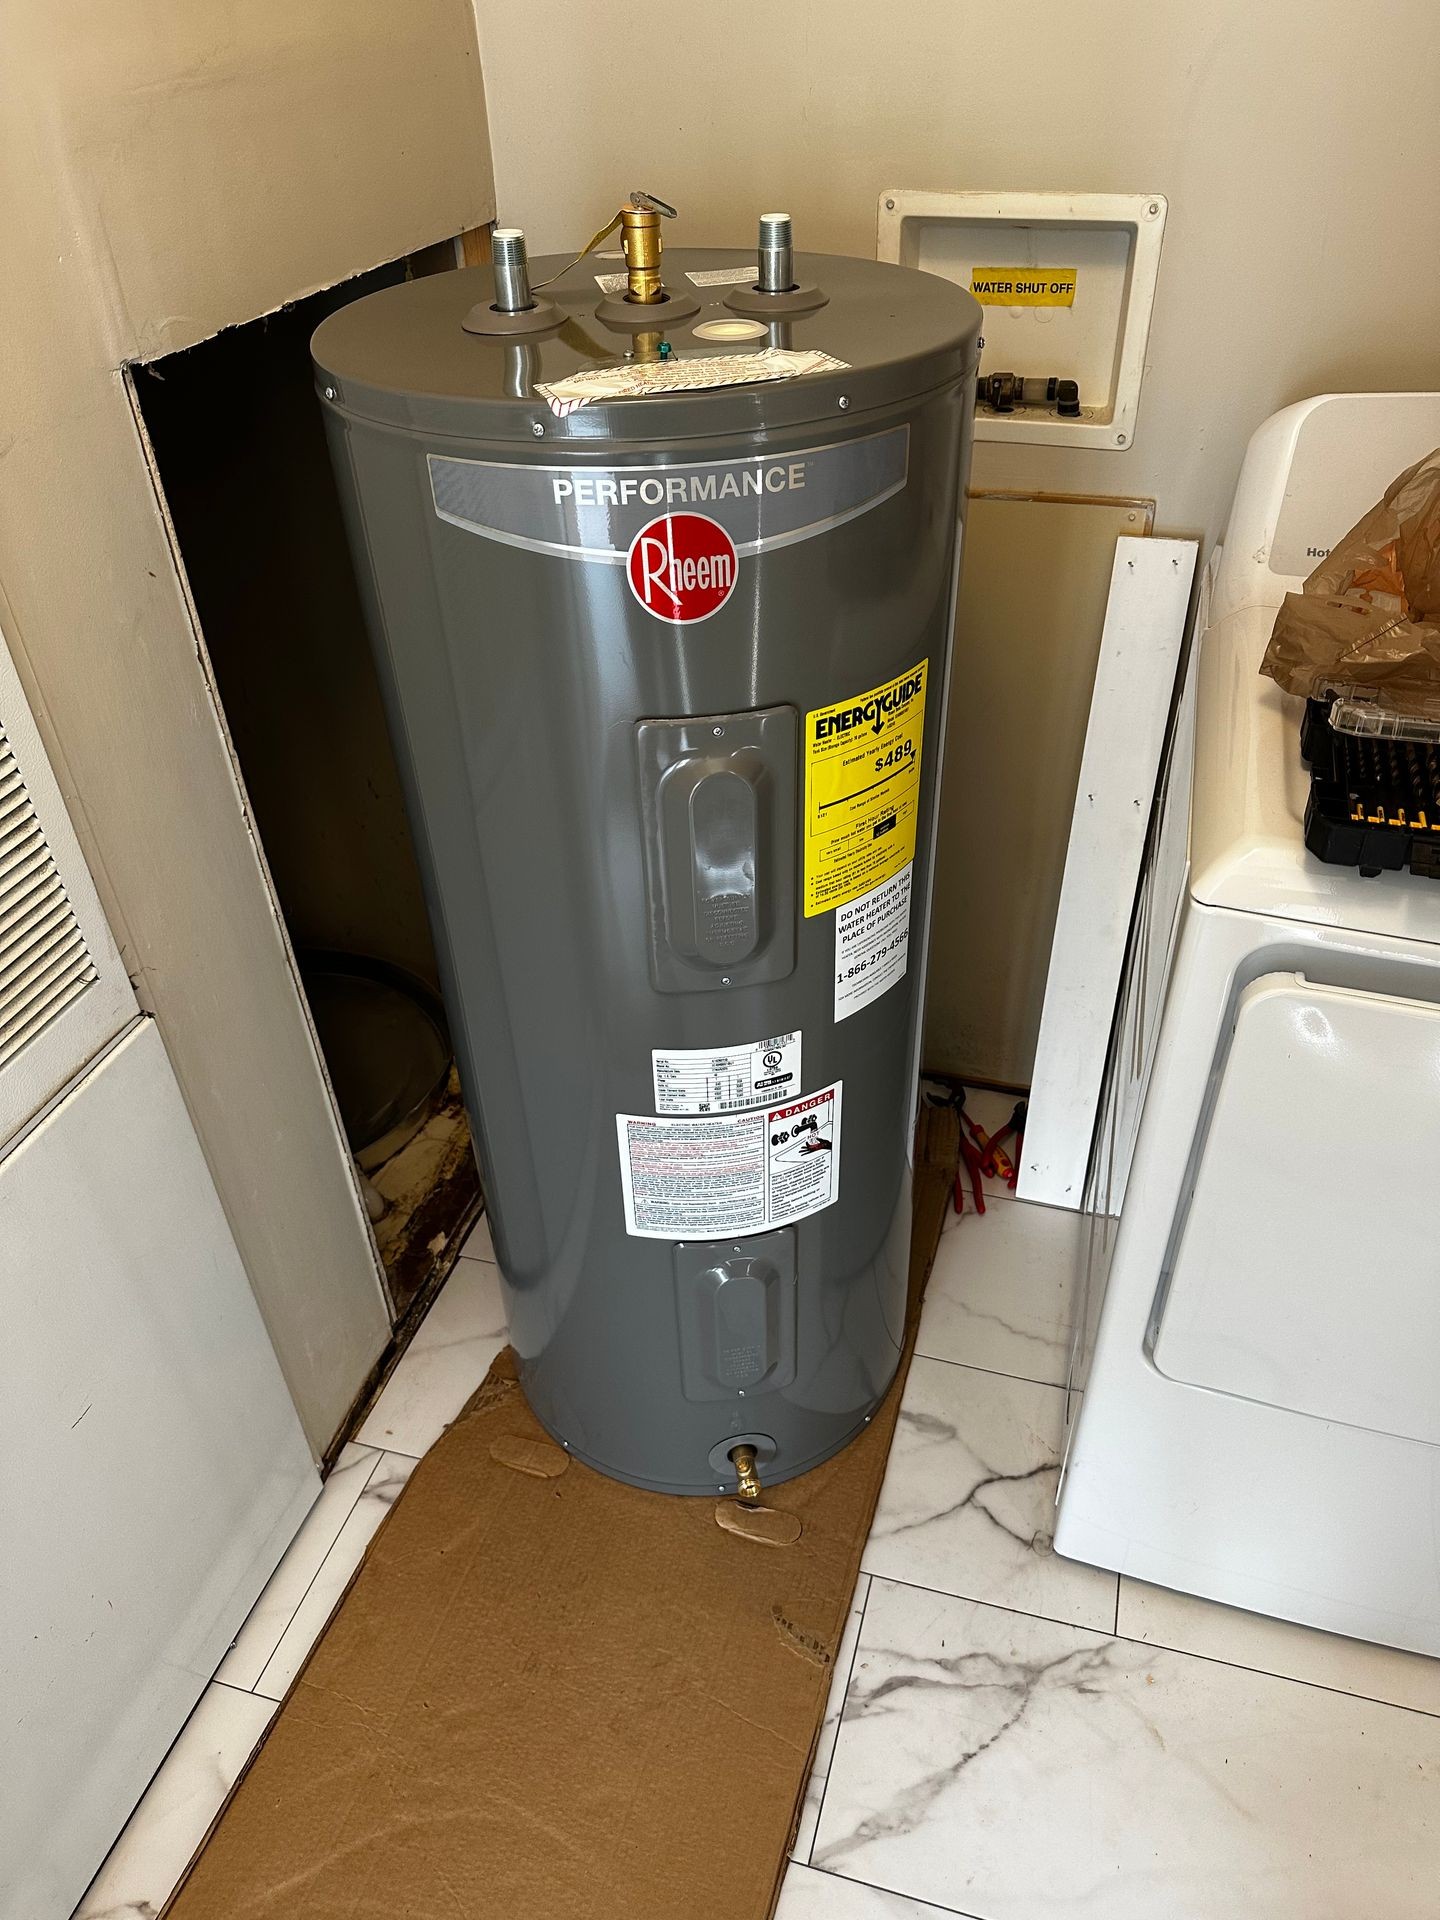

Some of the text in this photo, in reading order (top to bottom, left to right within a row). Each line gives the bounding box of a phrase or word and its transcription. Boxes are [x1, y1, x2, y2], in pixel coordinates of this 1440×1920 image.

[973, 281, 1074, 294] WATER SHUT OFF
[552, 462, 806, 506] PERFORMANCE
[640, 517, 731, 606] Rheem
[815, 671, 923, 740] ENERGYGUIDE
[842, 751, 866, 767] Estimated
[866, 746, 880, 758] Yearly
[880, 738, 894, 750] Energy
[874, 738, 912, 772] $489
[838, 881, 911, 934] WATER HEATER TO THE
[840, 871, 911, 922] DO NOT RETURN THIS
[842, 895, 908, 944] PLACE OF PURCHASE
[837, 928, 909, 984] 1-866-279-4566
[627, 1119, 657, 1127] WARNING
[737, 1115, 765, 1124] CAUTION
[785, 1093, 832, 1117] DANGER
[806, 1130, 820, 1140] HOT
